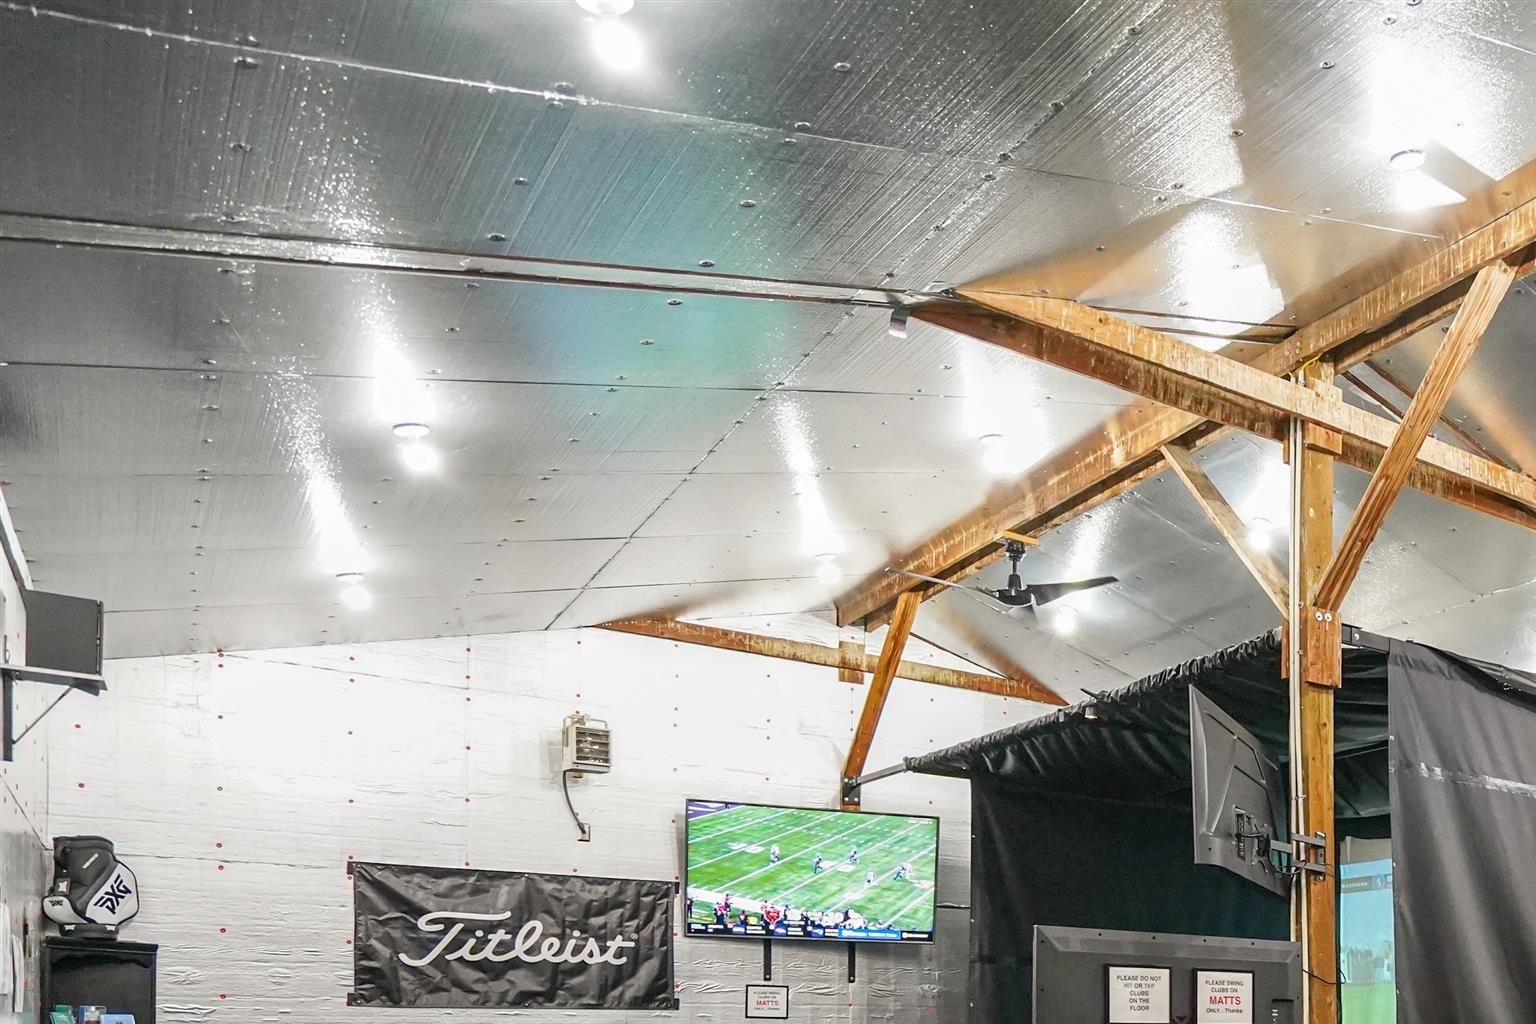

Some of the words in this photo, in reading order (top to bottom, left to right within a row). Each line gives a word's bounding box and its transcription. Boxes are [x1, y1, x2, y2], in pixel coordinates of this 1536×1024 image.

[94, 874, 132, 915] PXG
[398, 910, 635, 966] Titleist
[1209, 996, 1241, 1005] MATTS
